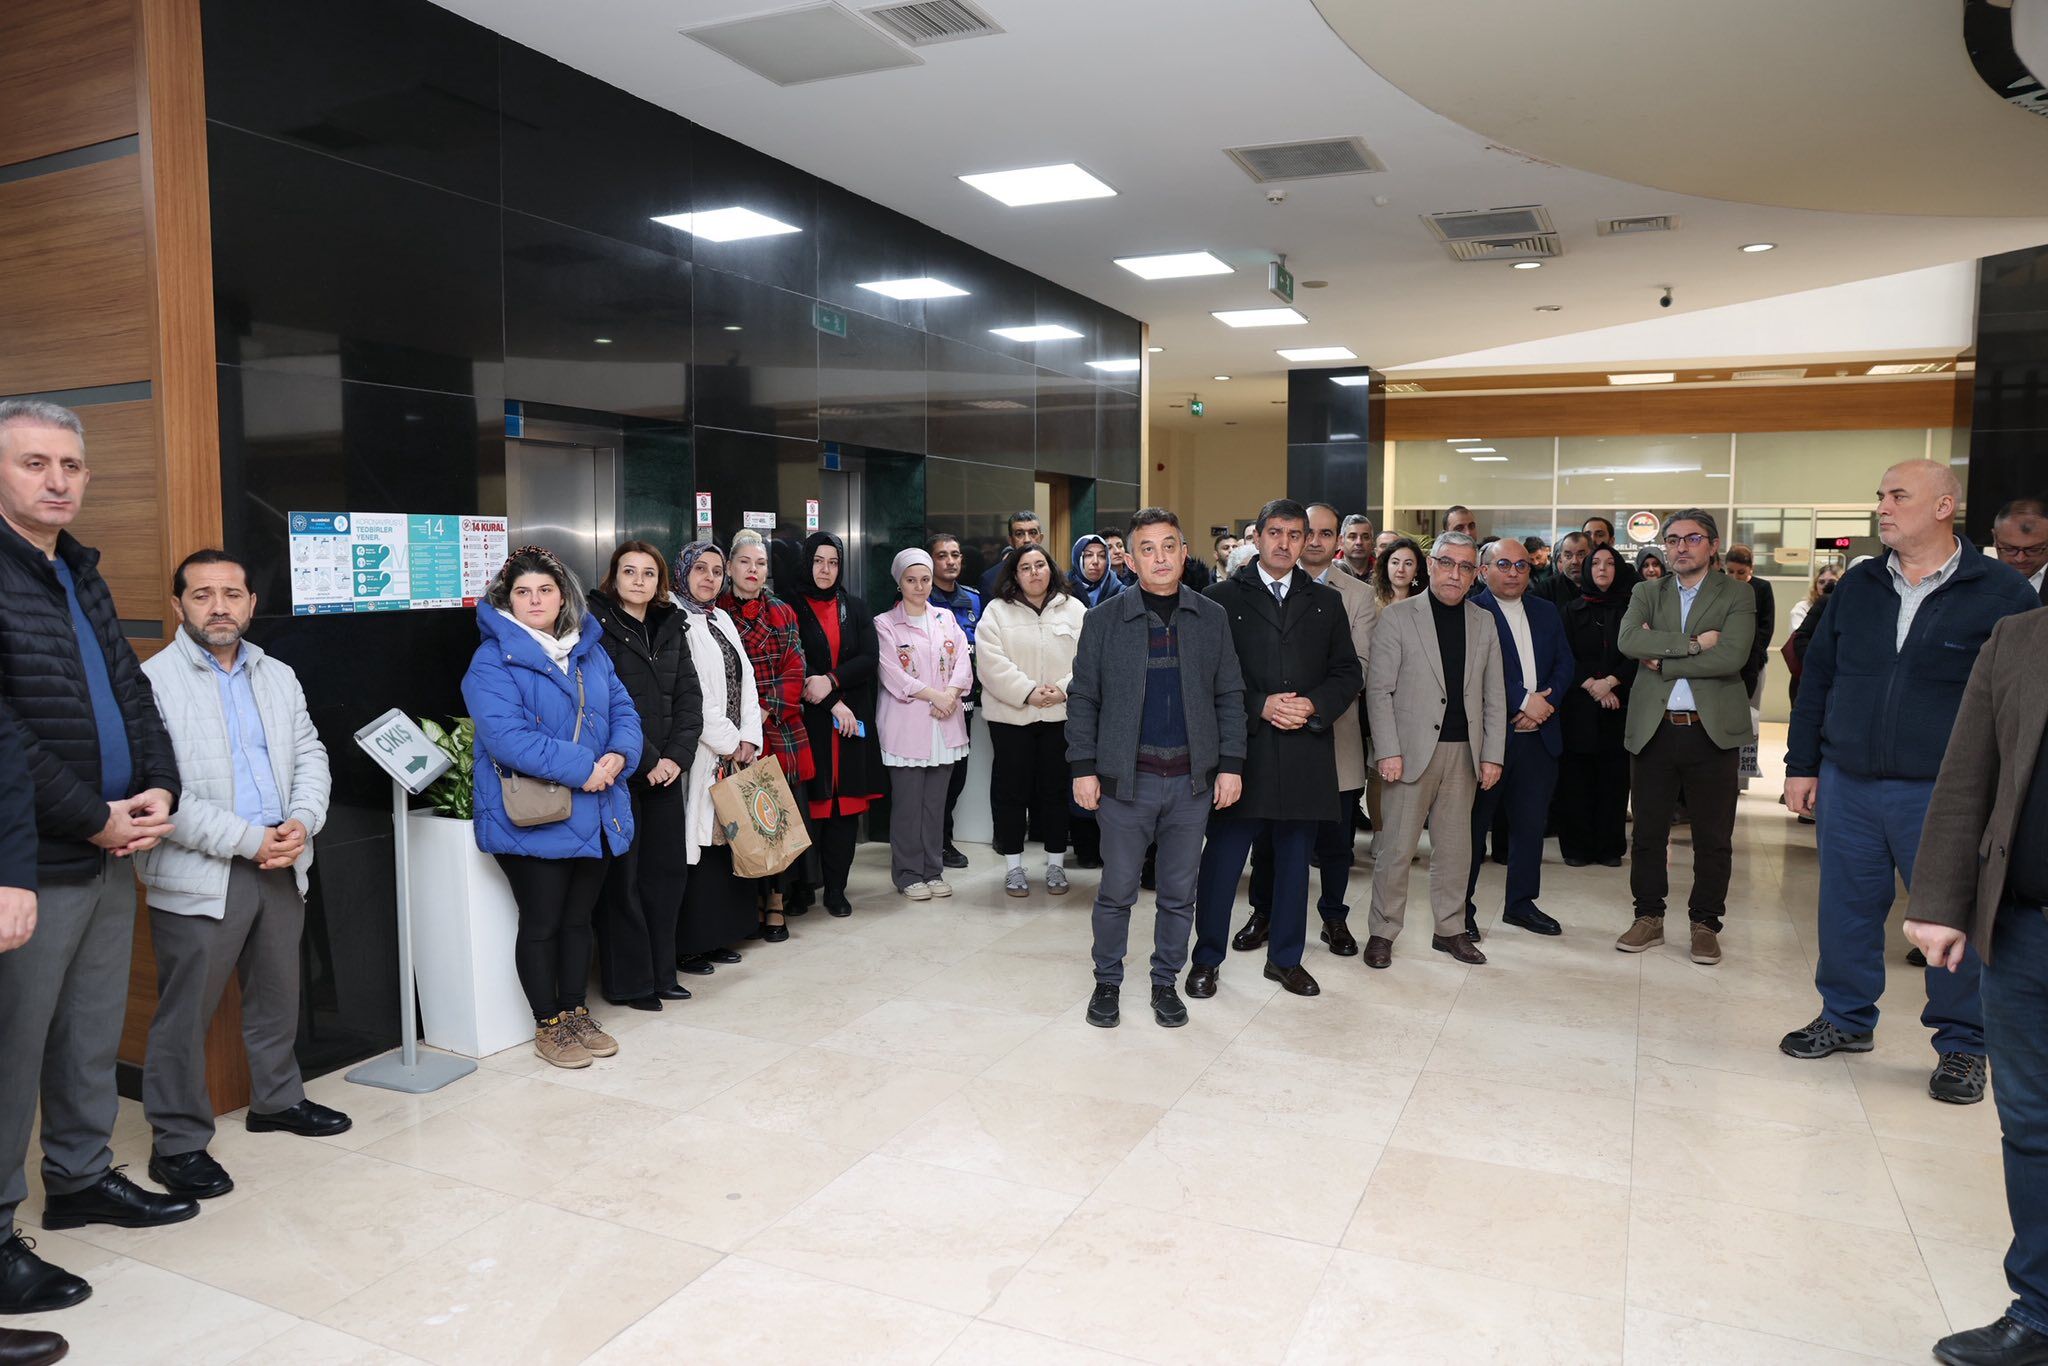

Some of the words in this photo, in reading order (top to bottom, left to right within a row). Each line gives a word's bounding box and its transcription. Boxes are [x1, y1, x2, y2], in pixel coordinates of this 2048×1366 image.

[424, 519, 444, 536] 14
[472, 522, 480, 531] 14
[481, 523, 505, 532] KURAL
[1836, 538, 1849, 547] 03
[375, 724, 413, 756] ÇIKIŞ
